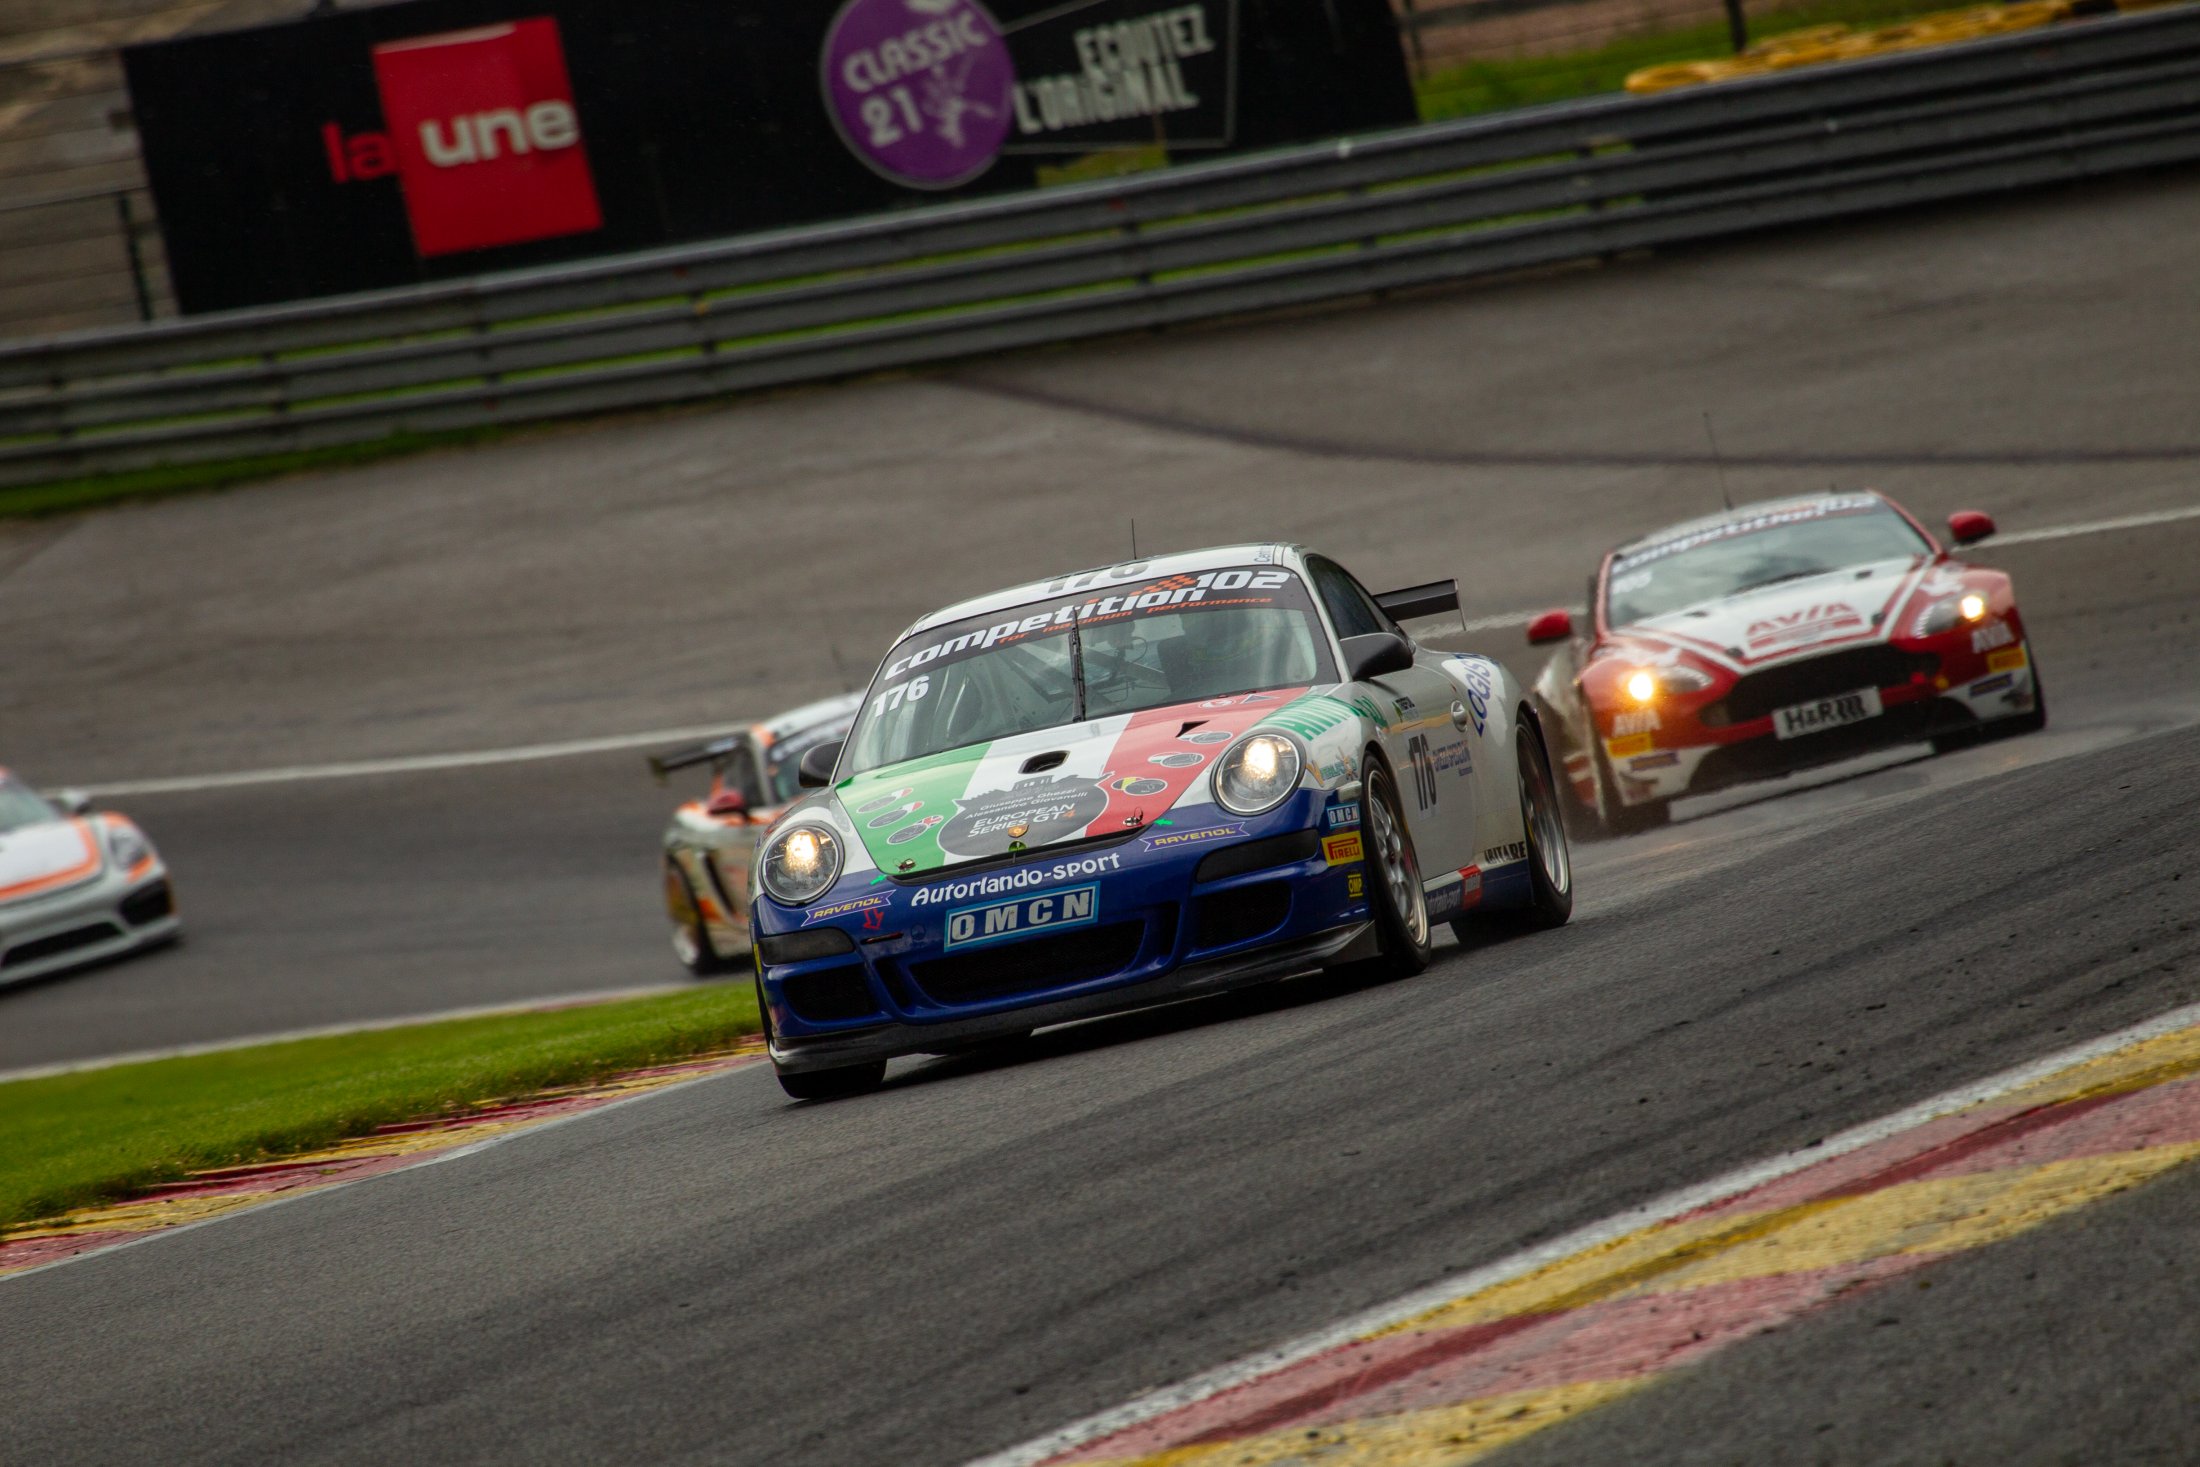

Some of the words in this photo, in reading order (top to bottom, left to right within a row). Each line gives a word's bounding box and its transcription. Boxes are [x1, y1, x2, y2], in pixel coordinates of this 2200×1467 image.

[843, 11, 989, 93] CLASSIC
[860, 87, 922, 148] 21
[322, 122, 396, 184] la
[419, 100, 580, 167] une
[1146, 598, 1273, 614] performance
[1746, 603, 1855, 637] AVIA
[873, 675, 930, 718] 176
[972, 802, 1076, 829] EUROPEAN
[980, 796, 1034, 811] Giuseppe
[967, 818, 1028, 838] SERIES
[1033, 809, 1076, 823] GT4
[1154, 826, 1237, 847] RAVENOL
[1327, 837, 1361, 860] PIRELLI
[911, 852, 1120, 906] Autorlando-sport
[813, 897, 882, 920] RAVENOL
[951, 889, 1091, 941] OMCN
